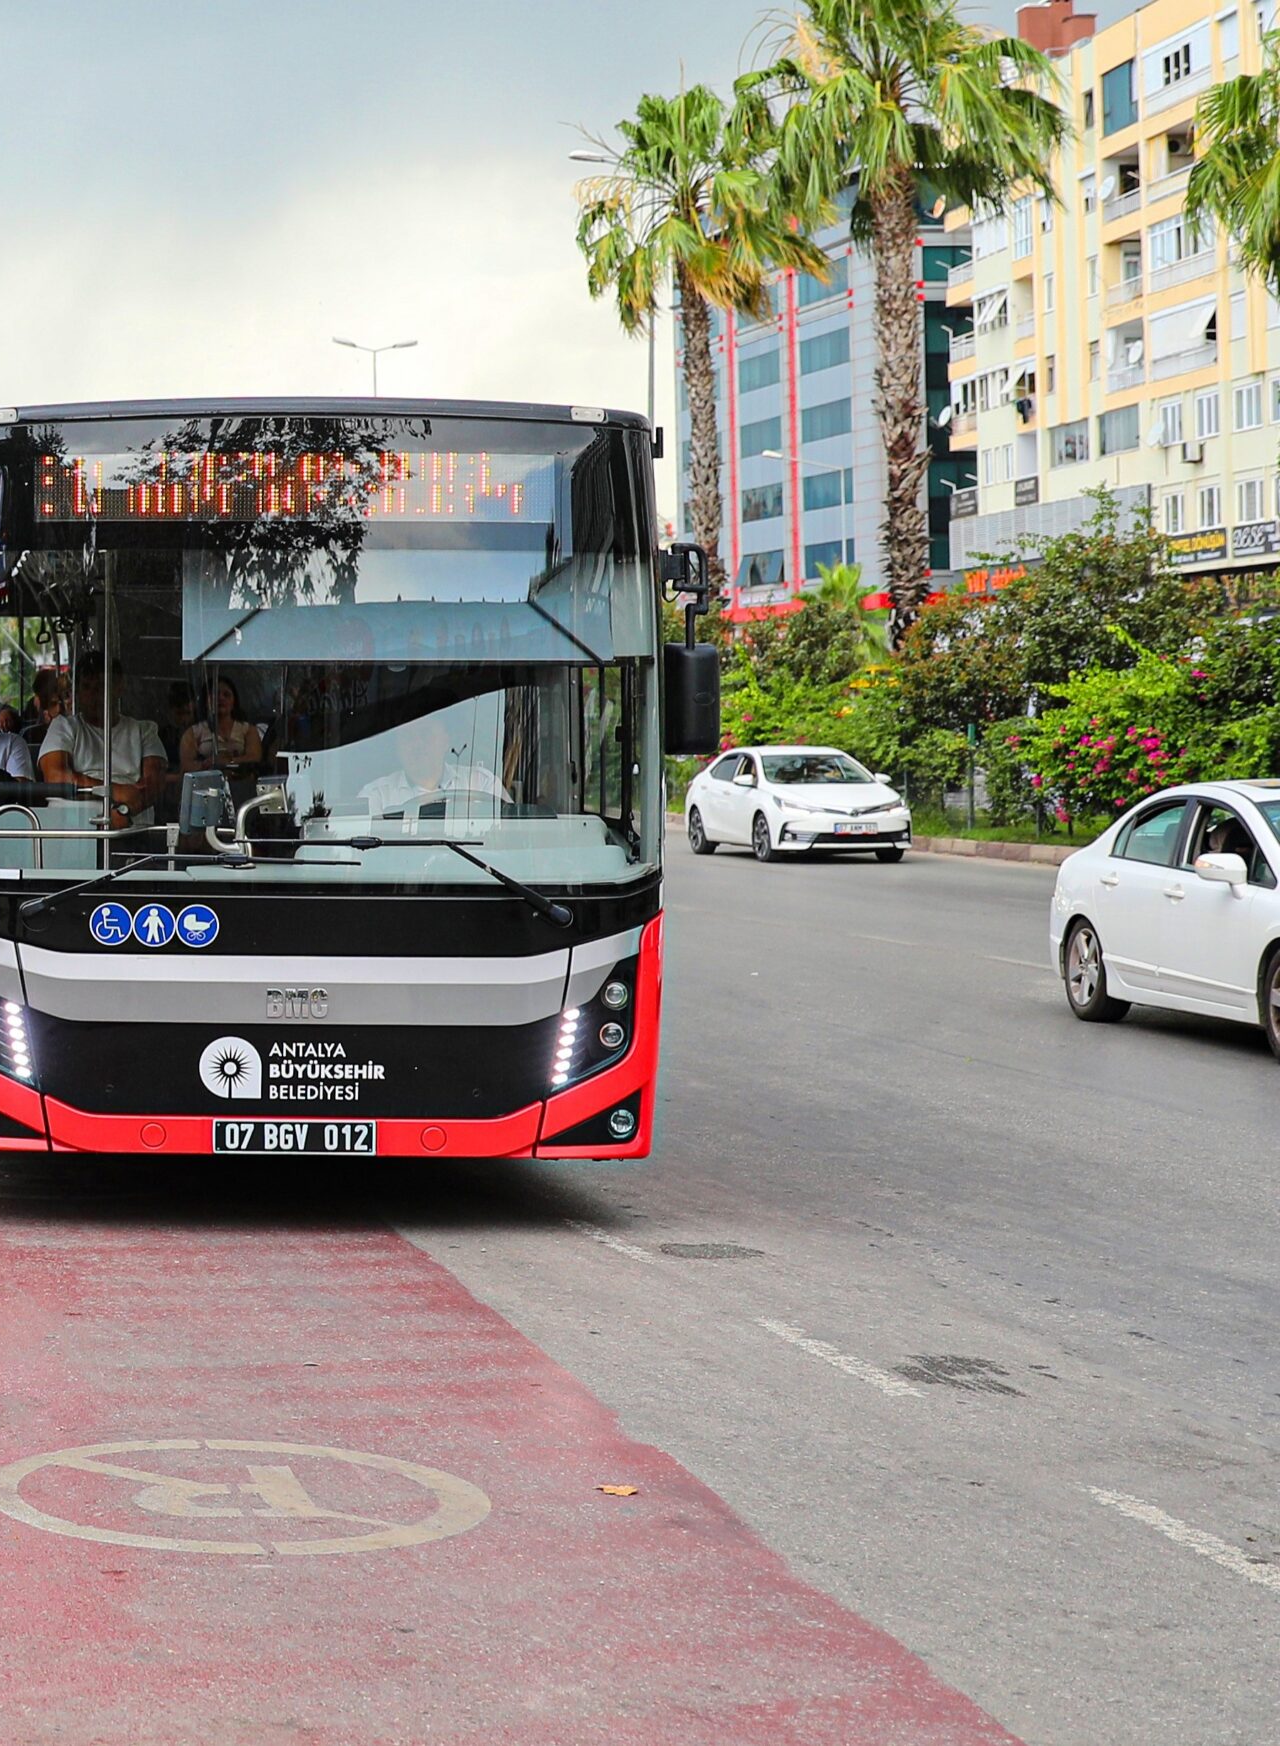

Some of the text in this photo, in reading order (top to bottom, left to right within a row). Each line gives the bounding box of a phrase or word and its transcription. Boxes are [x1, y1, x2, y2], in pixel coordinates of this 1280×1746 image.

[266, 987, 328, 1018] BMC
[268, 1042, 346, 1058] ANTALYA
[269, 1082, 359, 1100] BELEDİYESİ
[225, 1123, 368, 1150] 07 BGV 012
